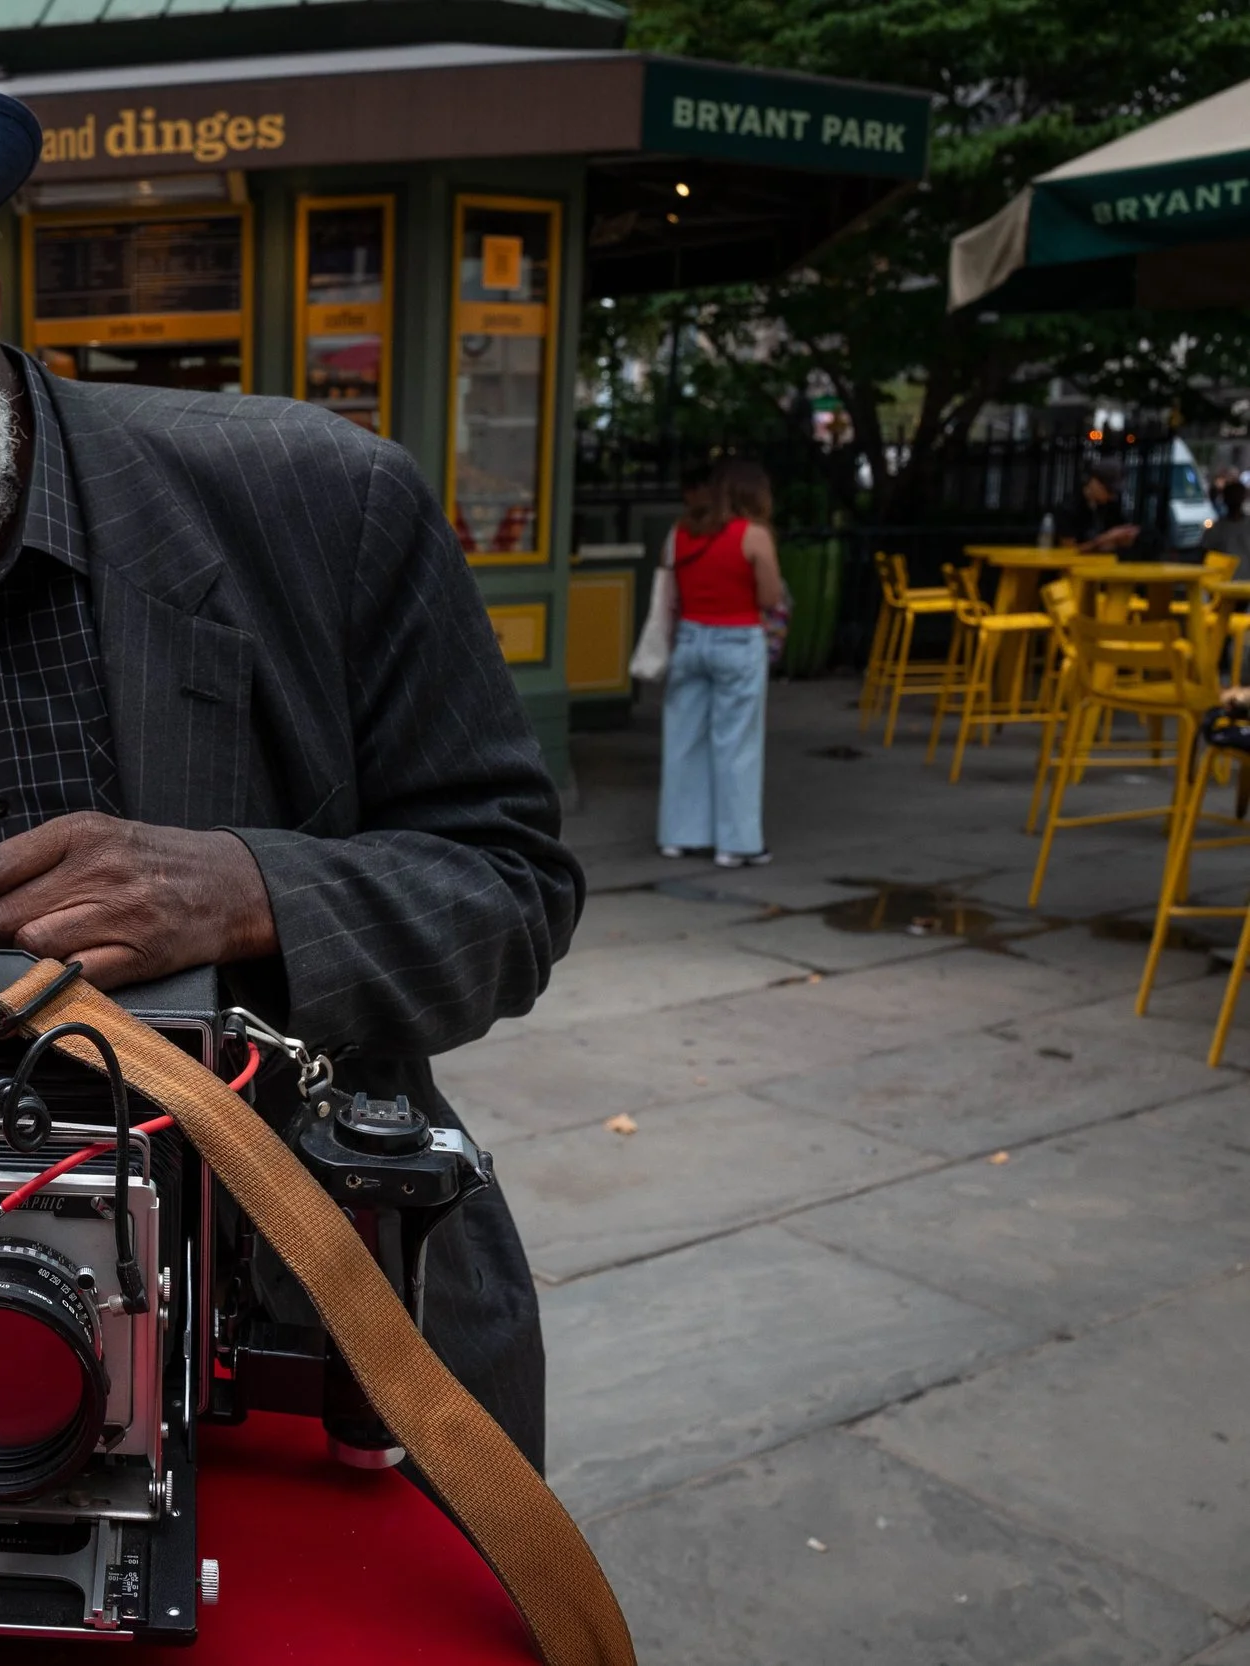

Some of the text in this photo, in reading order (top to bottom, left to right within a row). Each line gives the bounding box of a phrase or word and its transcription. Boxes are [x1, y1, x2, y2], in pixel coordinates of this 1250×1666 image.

[40, 107, 286, 162] and dinges
[672, 96, 907, 153] BRYANT PARK
[1091, 178, 1249, 225] BRYANT
[38, 1268, 50, 1278] 400
[49, 1274, 61, 1286] 250
[60, 1283, 72, 1295] 125
[68, 1292, 78, 1302] 60
